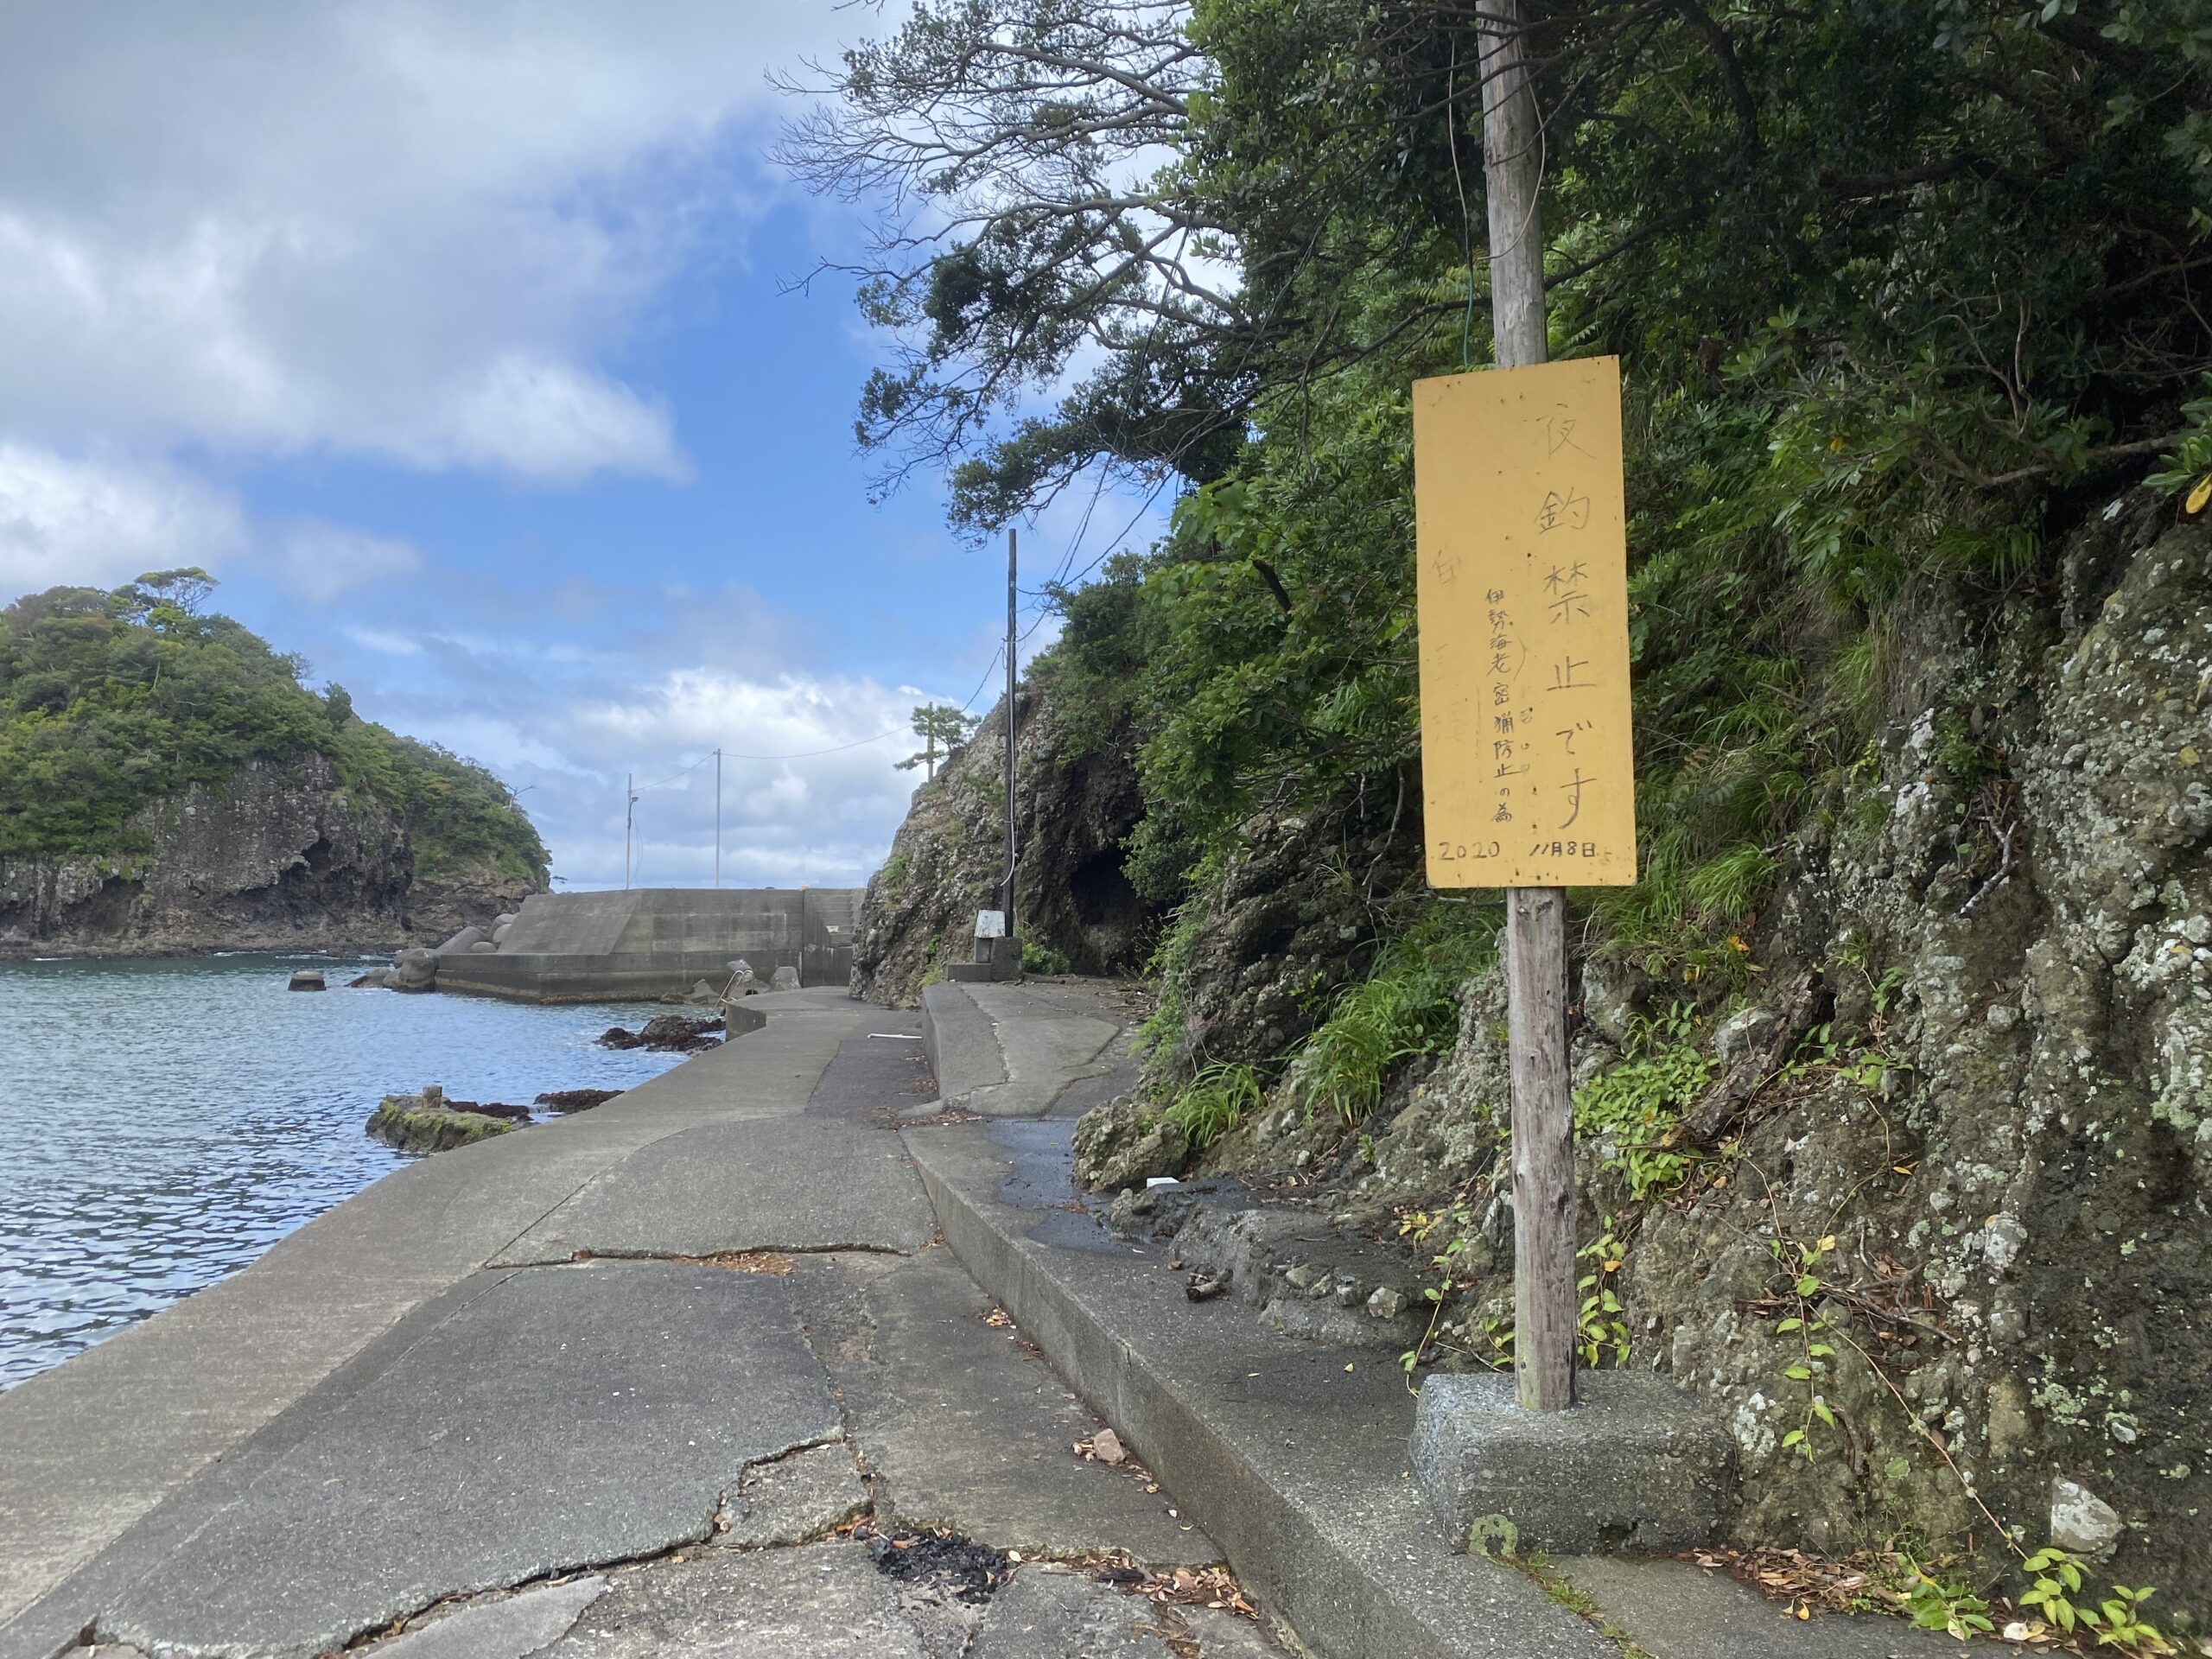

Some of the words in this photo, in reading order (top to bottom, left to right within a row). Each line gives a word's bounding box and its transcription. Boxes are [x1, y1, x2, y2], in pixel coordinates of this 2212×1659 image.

[1534, 402, 1598, 830] 夜釣禁止です
[1439, 841, 1500, 861] 2020
